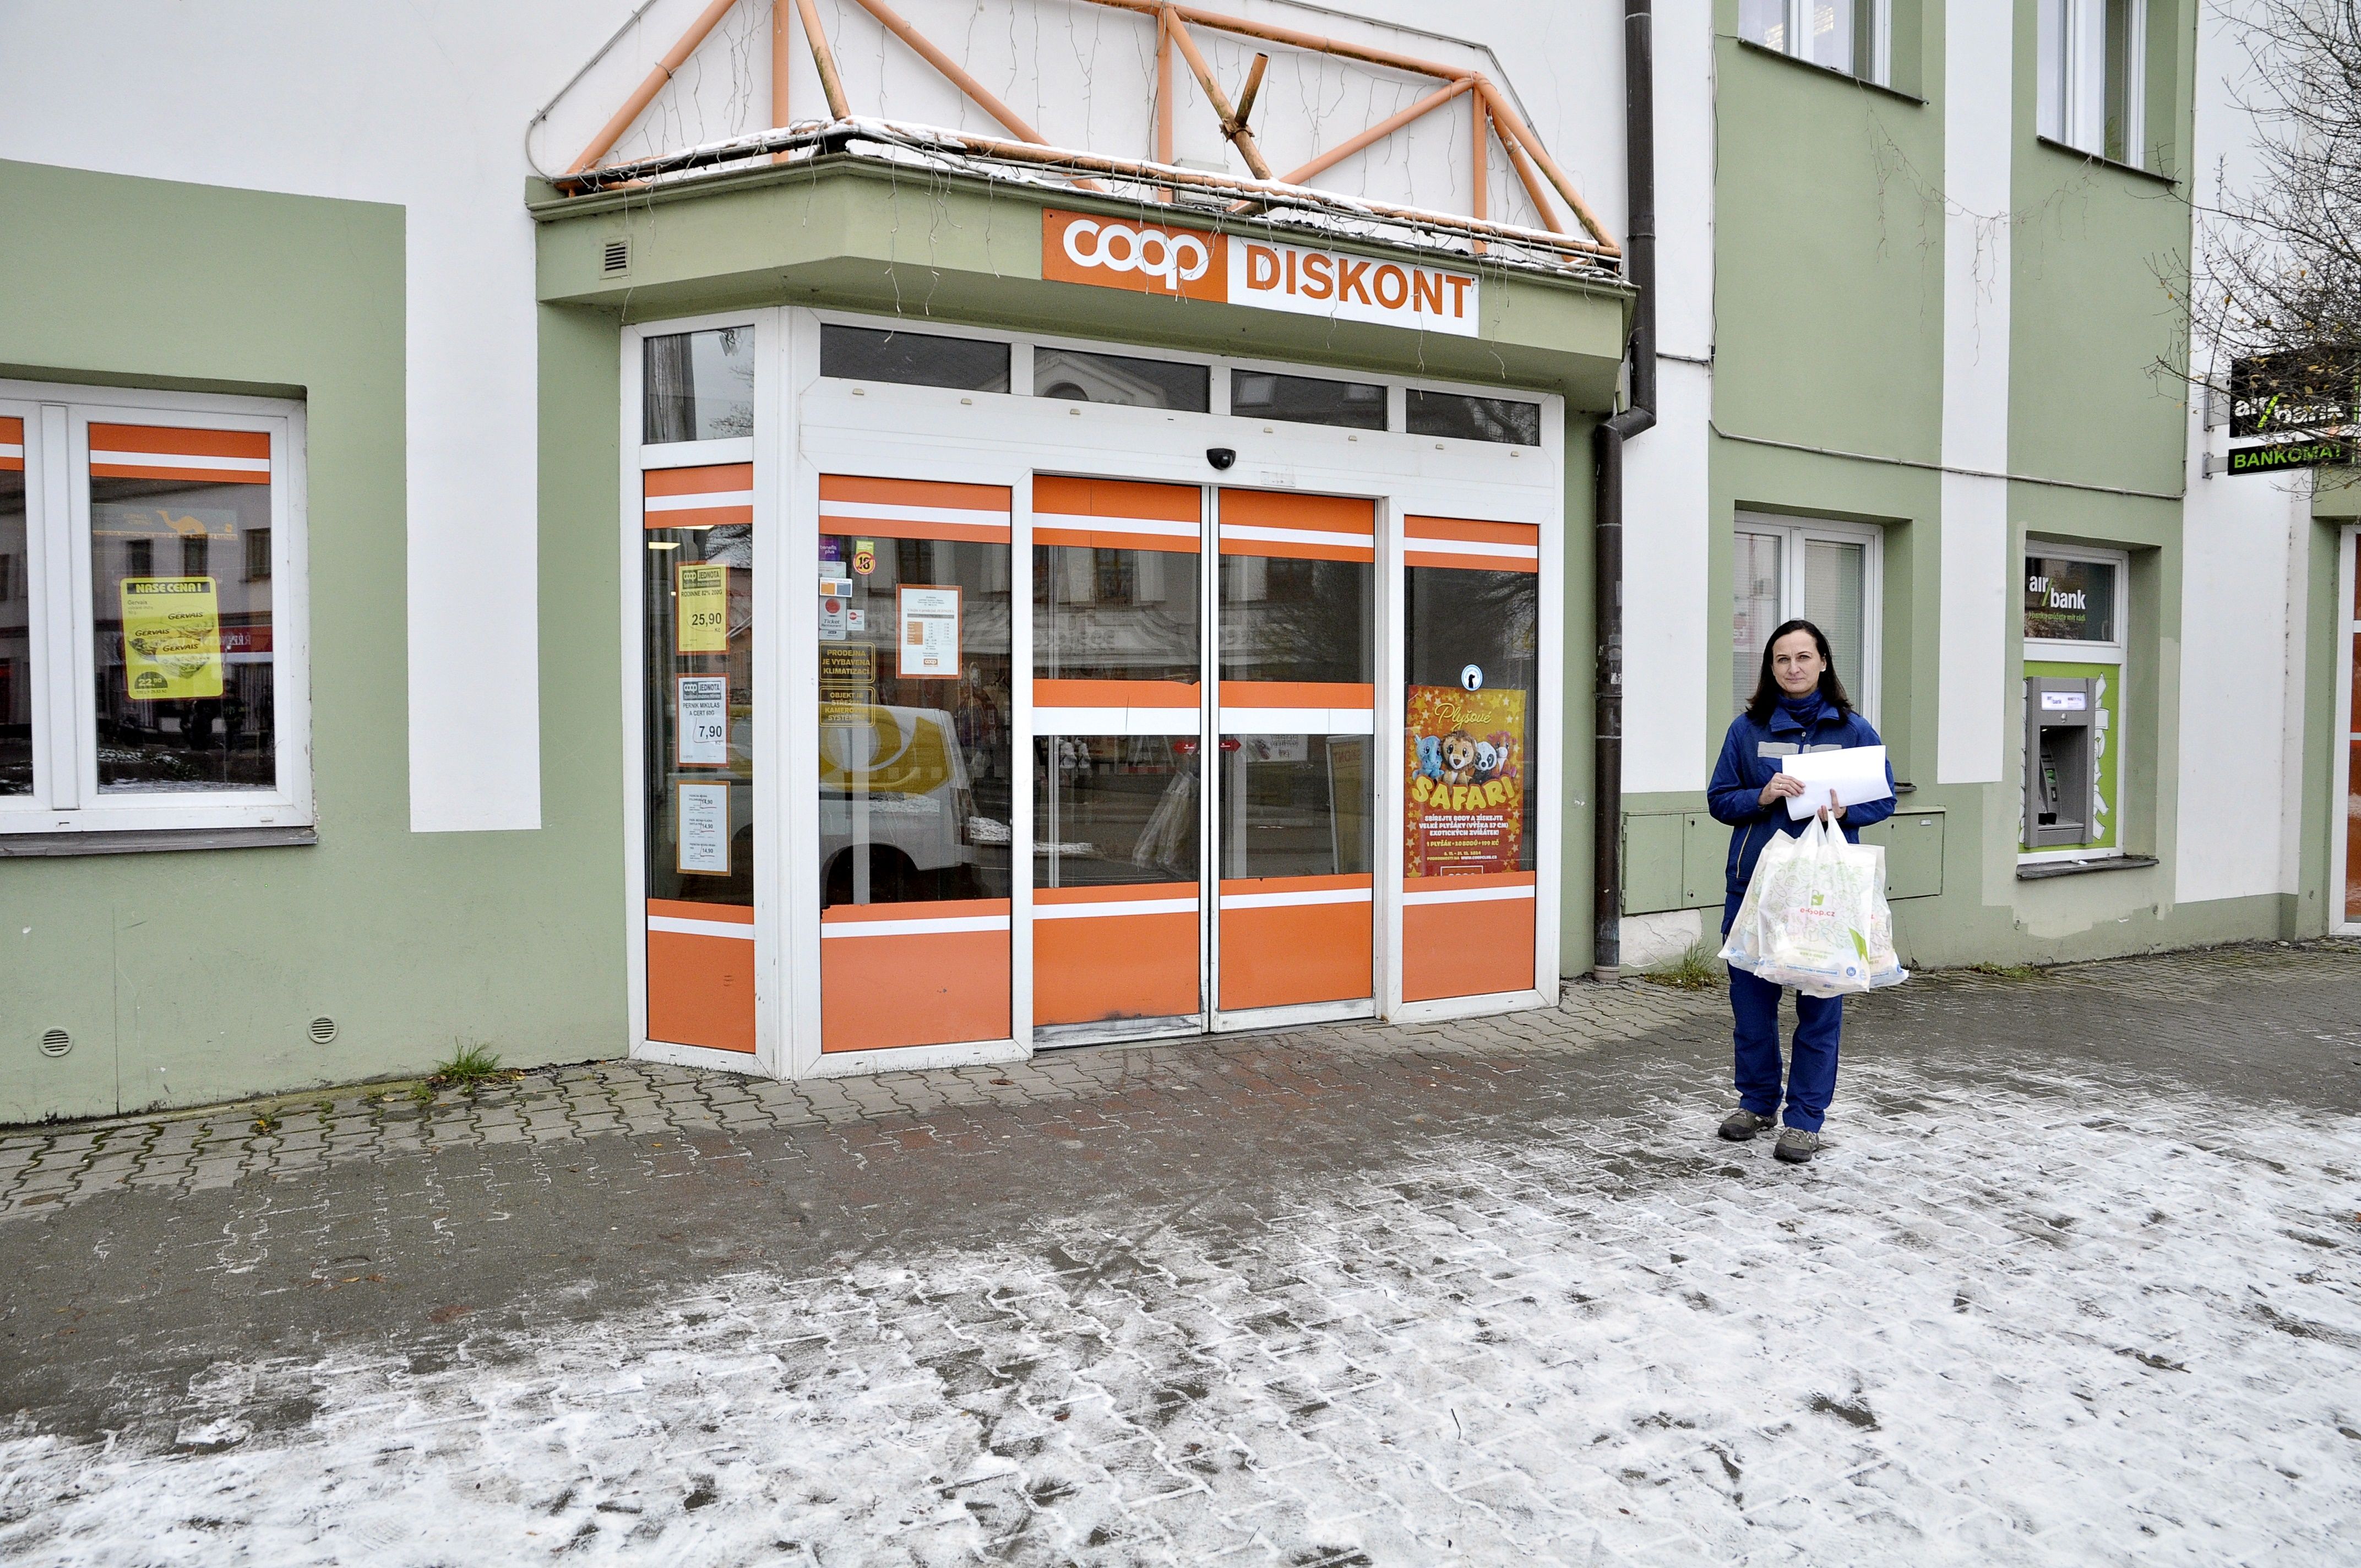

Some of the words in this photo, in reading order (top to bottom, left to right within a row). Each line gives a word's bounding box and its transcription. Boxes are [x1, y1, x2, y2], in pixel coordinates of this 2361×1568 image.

[1063, 219, 1209, 291] coop
[1247, 244, 1472, 319] DISKONT
[859, 557, 870, 569] 18
[699, 570, 720, 579] JEDNOTA
[2029, 576, 2049, 592] air
[2050, 587, 2086, 609] bank
[692, 612, 722, 627] 25,90
[162, 643, 199, 652] GERVAIS
[1434, 703, 1492, 732] Plyšové
[699, 725, 722, 739] 7,90
[1412, 775, 1515, 812] SAFARI
